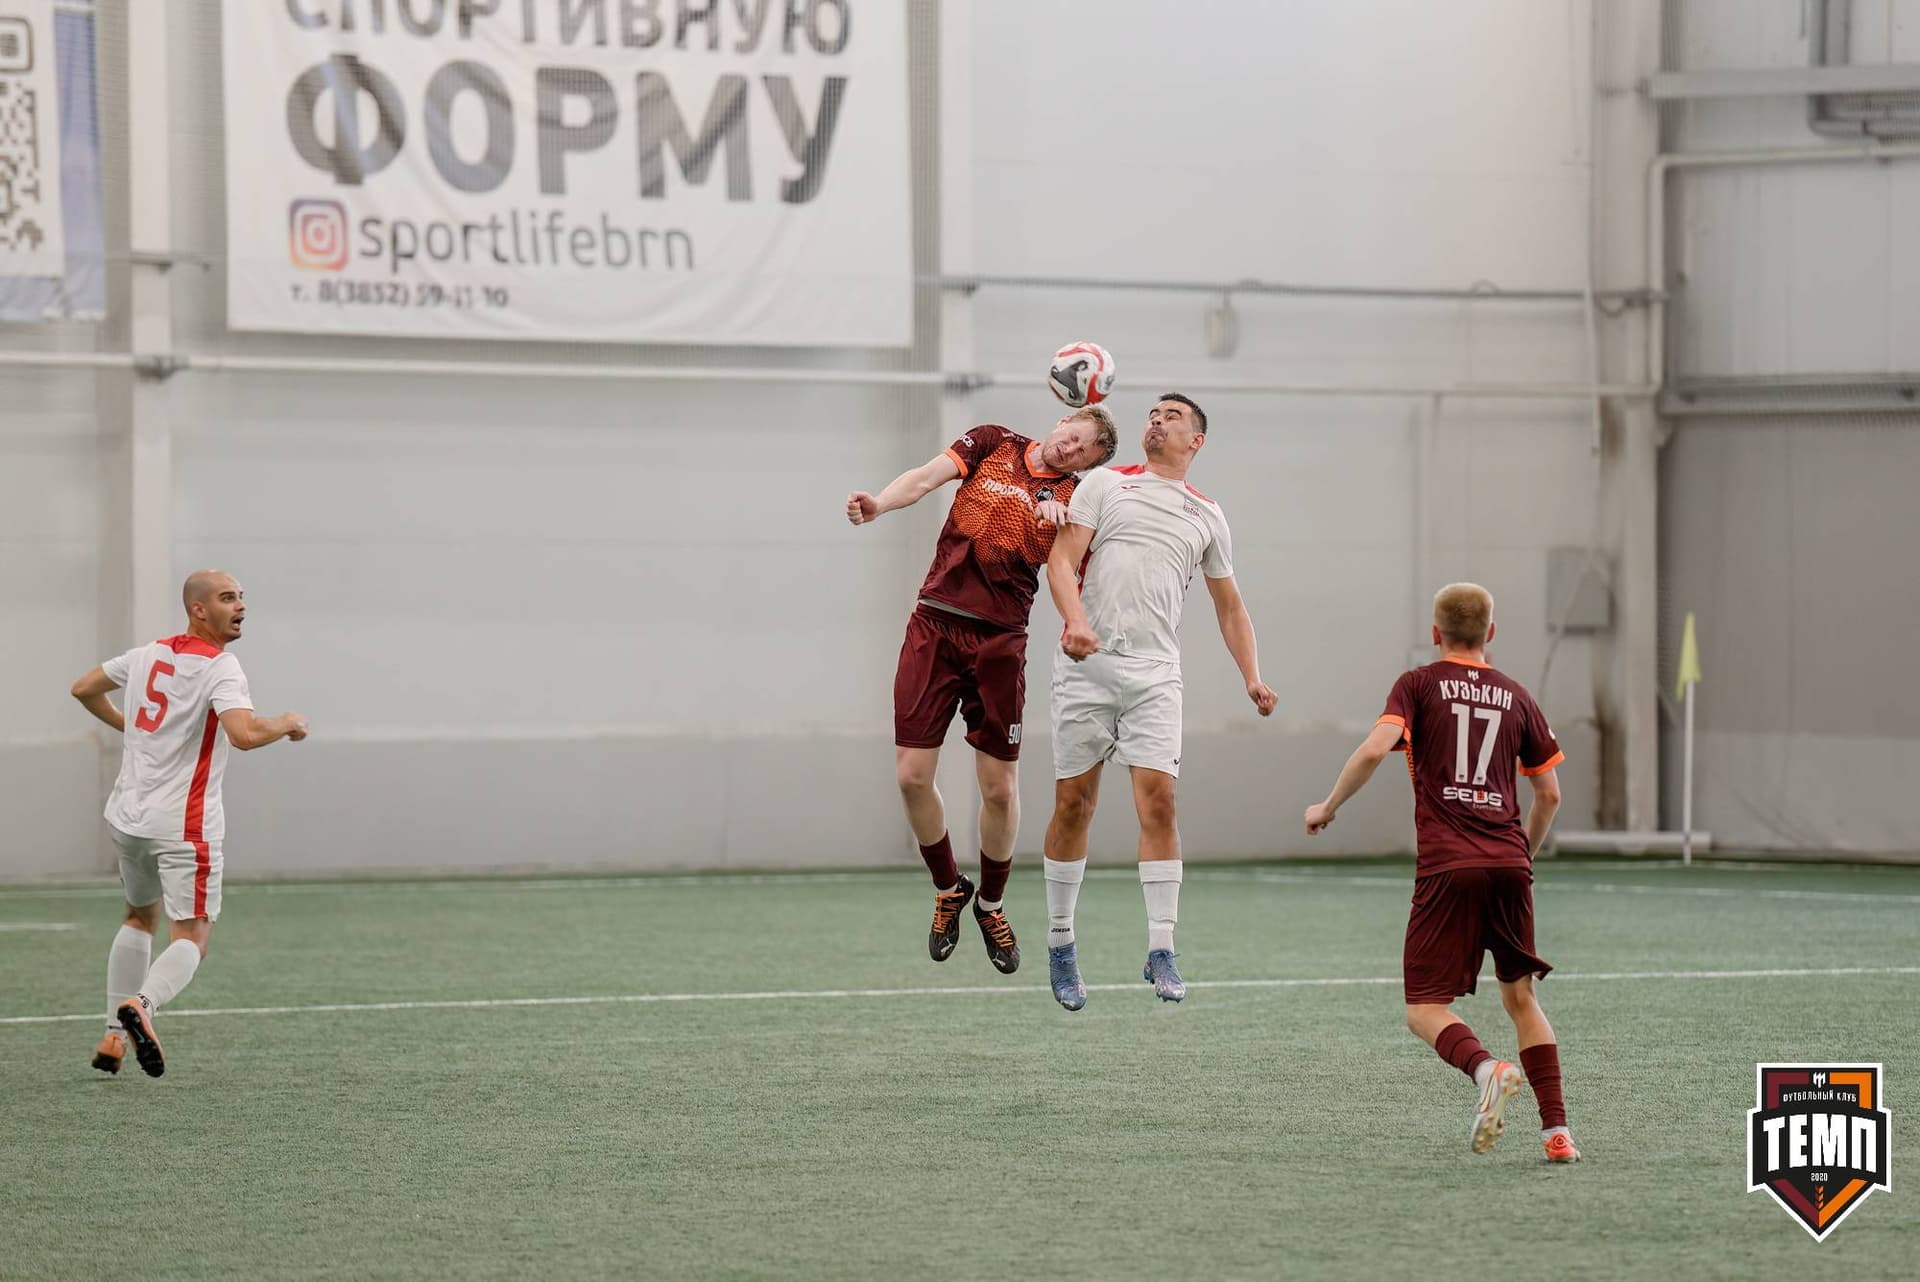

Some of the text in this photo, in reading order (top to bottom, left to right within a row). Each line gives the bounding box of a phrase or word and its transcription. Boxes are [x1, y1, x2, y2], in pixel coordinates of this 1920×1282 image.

[285, 53, 849, 204] ФОРМУ
[358, 206, 695, 273] sportlifebrn
[134, 659, 176, 734] 5
[1438, 679, 1513, 711] КУЗЬКИН
[1008, 723, 1022, 745] 90
[1451, 702, 1502, 786] 17
[1442, 786, 1503, 807] SEUS
